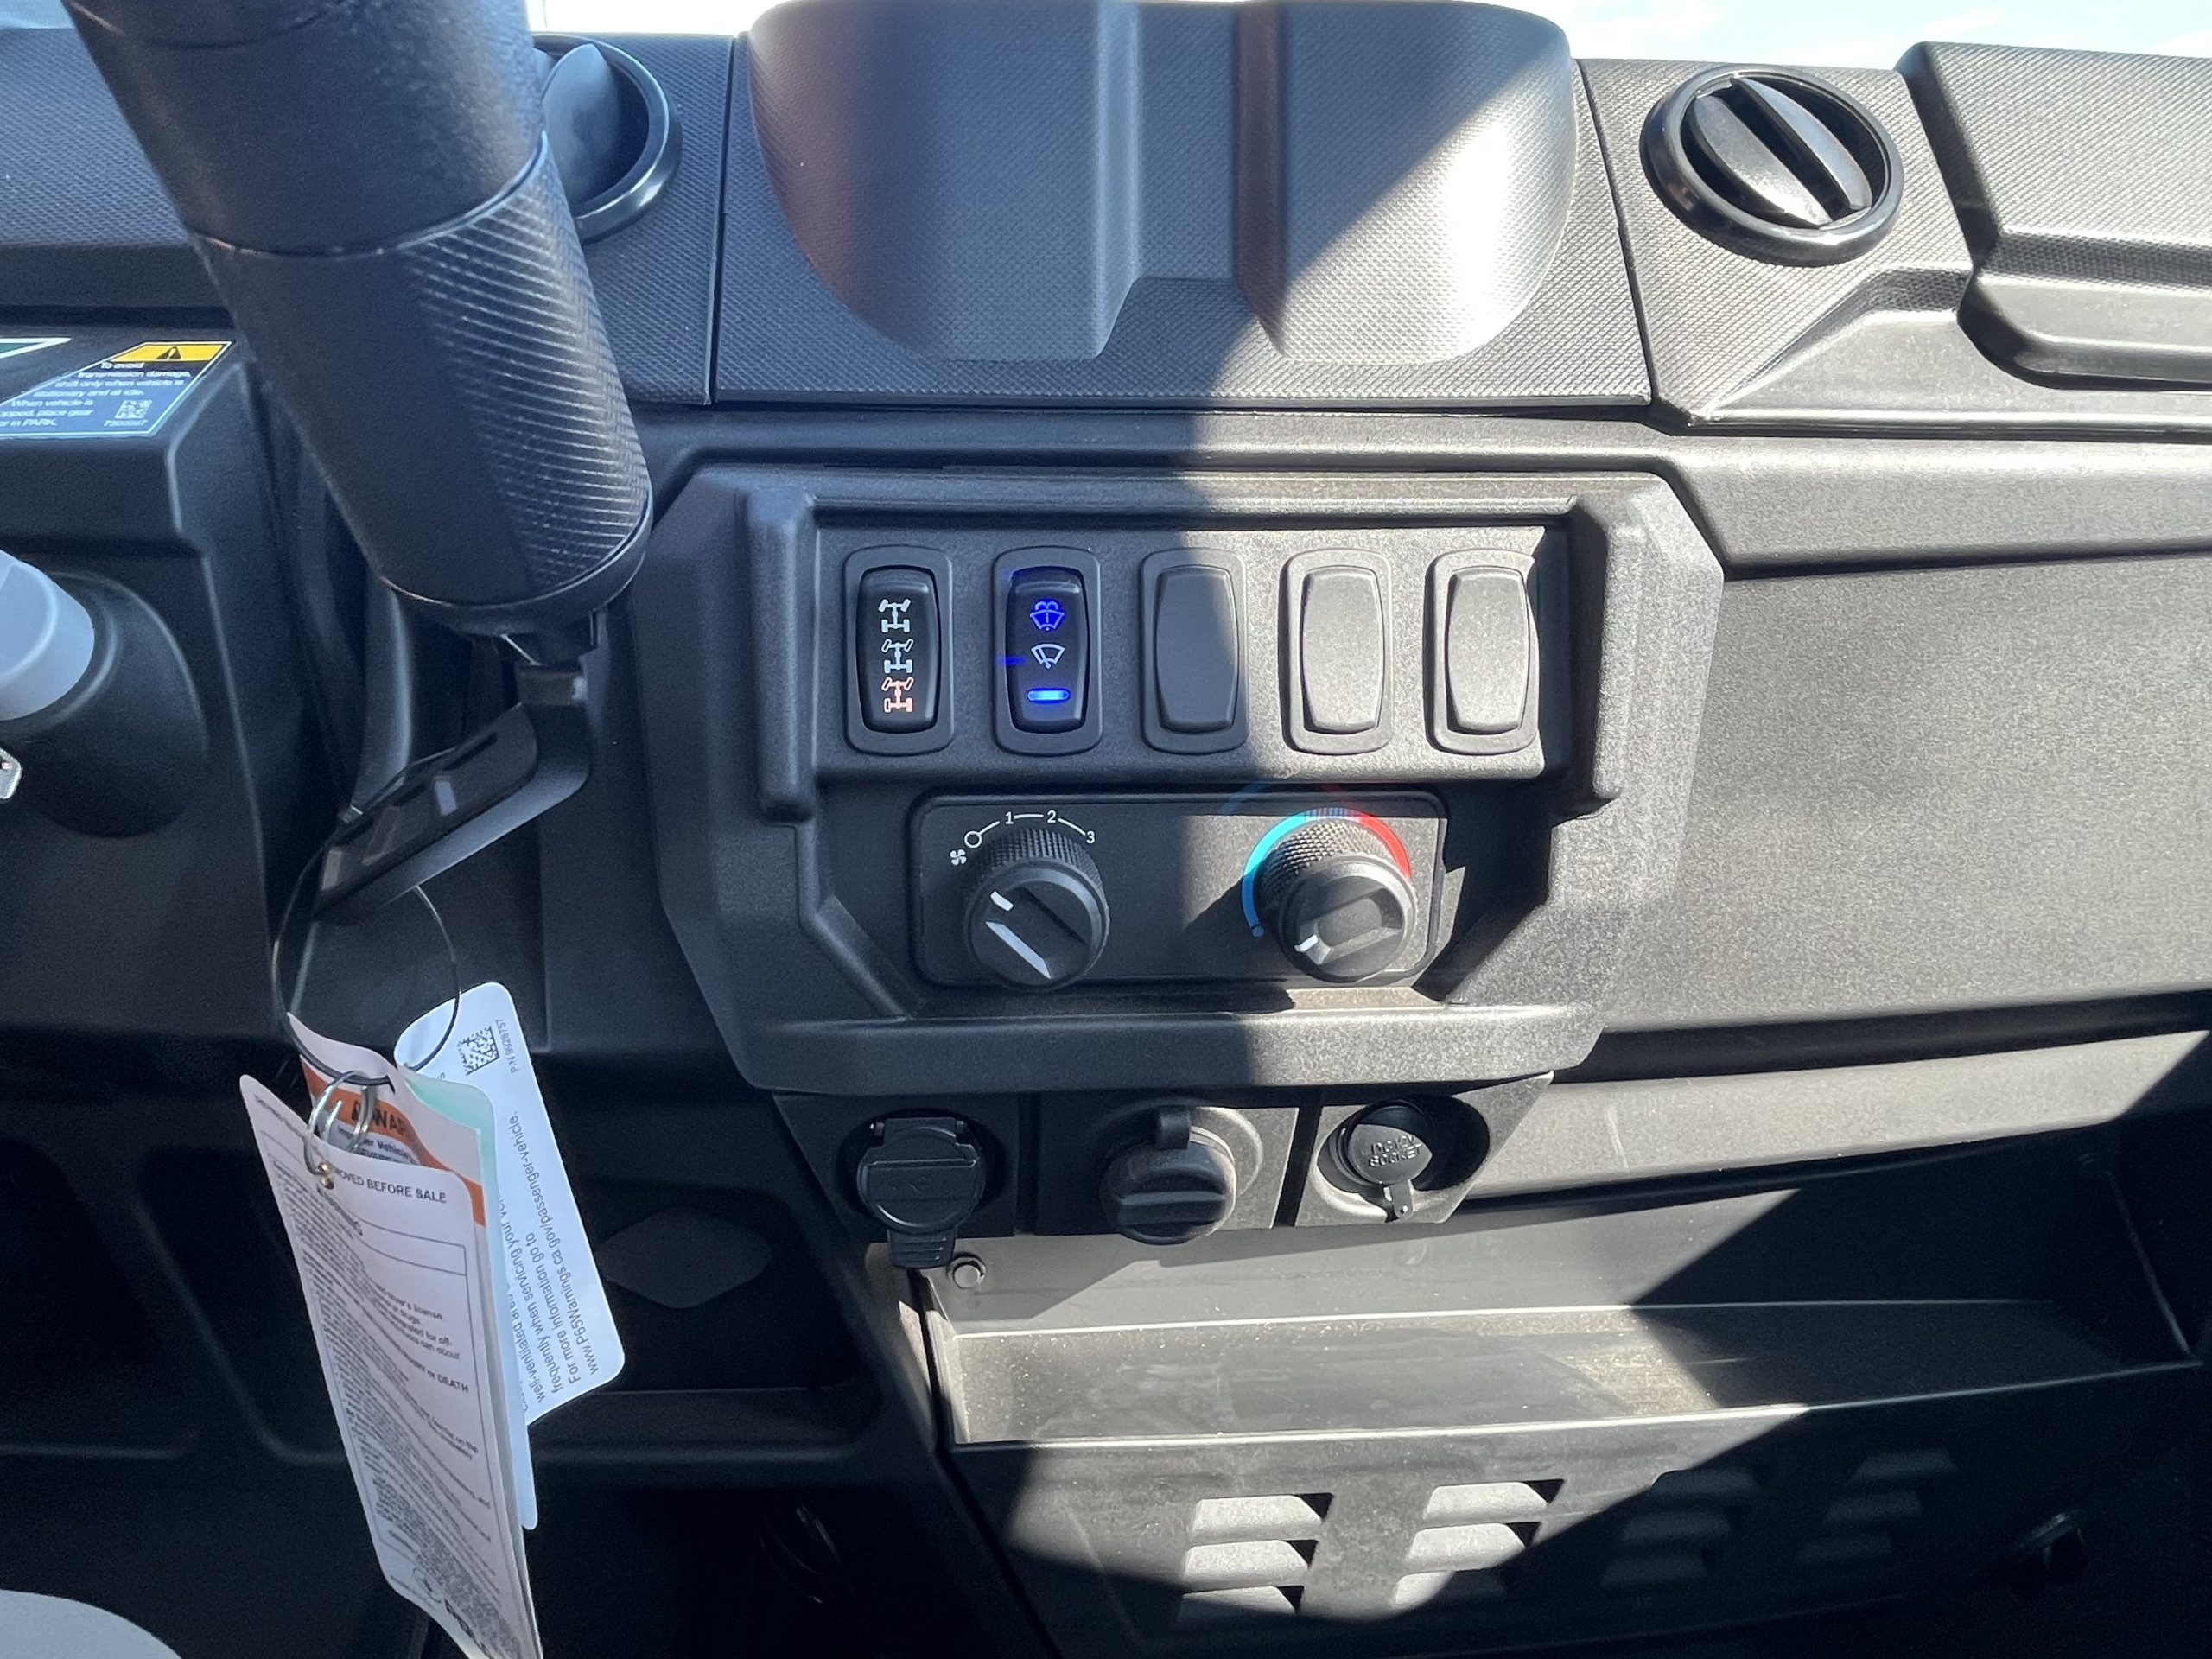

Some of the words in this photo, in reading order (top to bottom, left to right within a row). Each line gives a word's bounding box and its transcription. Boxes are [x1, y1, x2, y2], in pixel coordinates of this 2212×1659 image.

[1005, 811, 1014, 824] 1
[1047, 810, 1057, 823] 2
[1086, 830, 1095, 844] 3
[366, 1179, 412, 1198] BEFORE
[415, 1187, 447, 1204] SALE
[501, 1222, 520, 1249] your
[525, 1232, 537, 1247] to
[530, 1246, 544, 1263] go
[510, 1248, 534, 1301] servicing
[536, 1263, 564, 1331] information
[527, 1301, 544, 1336] when
[556, 1330, 574, 1361] more
[512, 1322, 546, 1403] well-ventilated
[537, 1335, 564, 1393] frequently
[567, 1362, 582, 1384] For
[437, 1374, 468, 1393] DEATH
